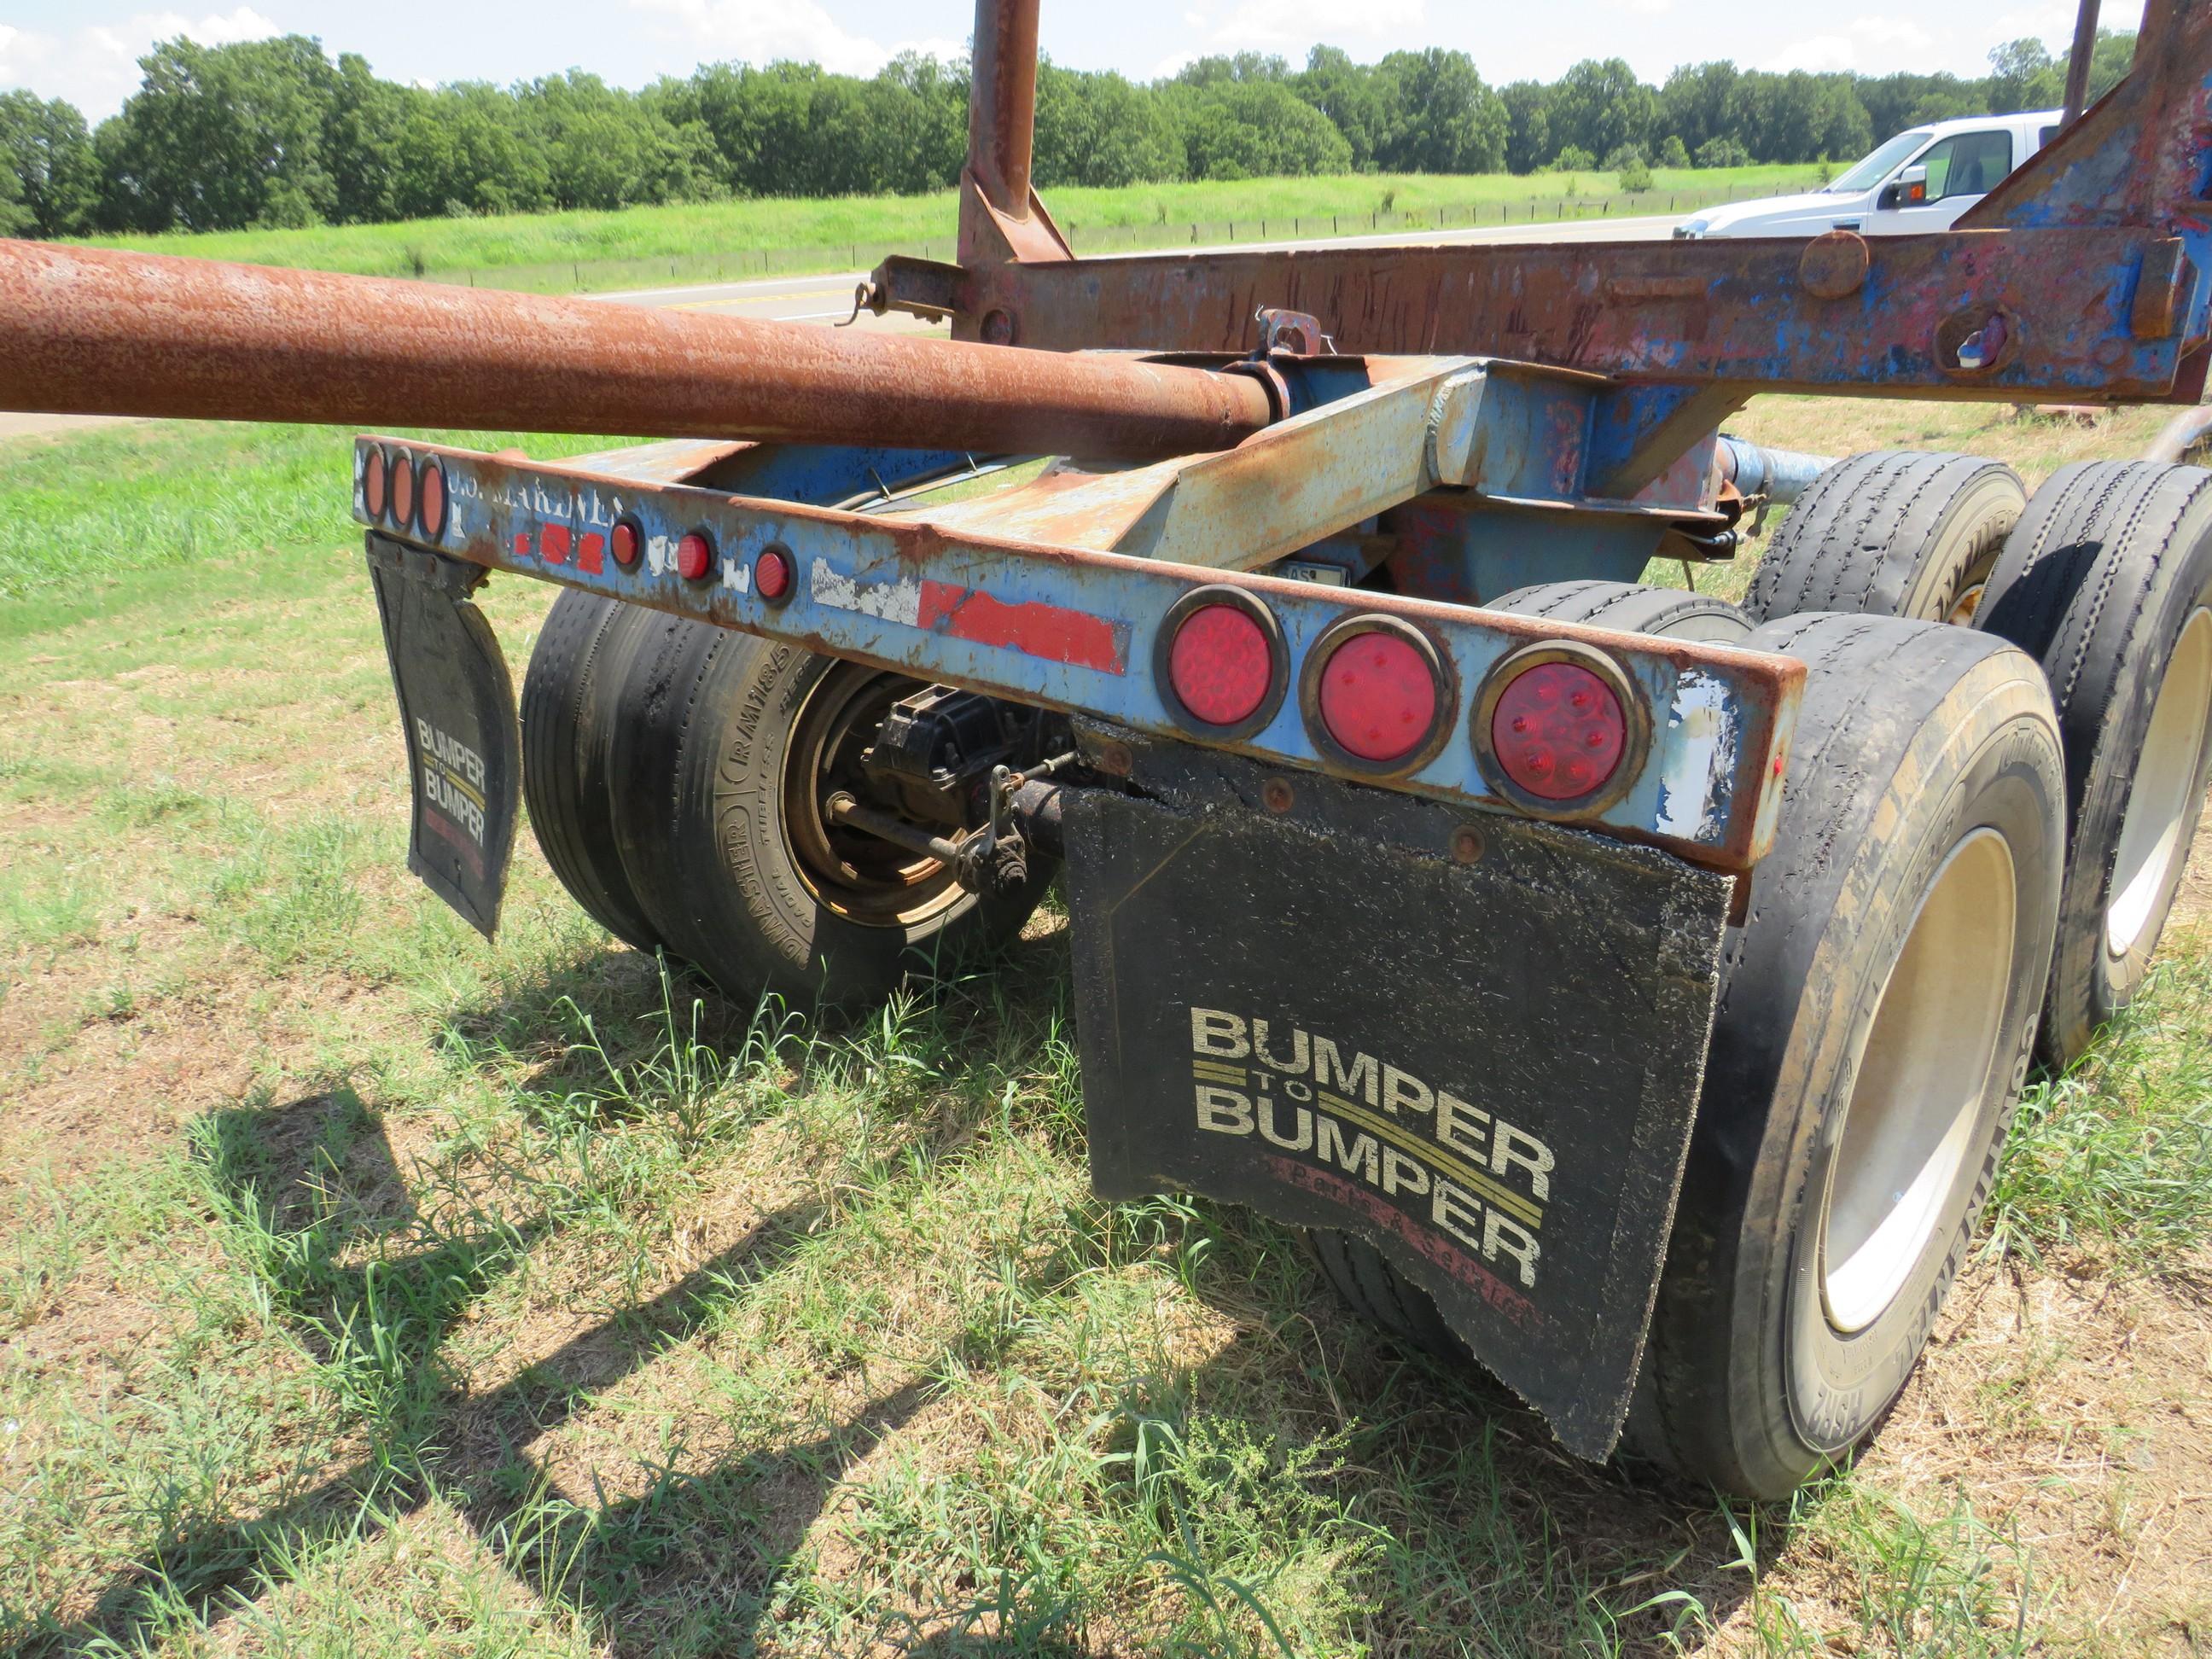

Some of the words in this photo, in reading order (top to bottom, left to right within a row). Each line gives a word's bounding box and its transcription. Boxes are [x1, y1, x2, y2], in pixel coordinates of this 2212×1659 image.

[416, 716, 486, 794] BUMPER
[433, 757, 445, 775] TO
[424, 766, 485, 847] BUMPER
[1190, 1006, 1556, 1203] BUMPER
[1250, 1069, 1313, 1102] TO
[1195, 1084, 1542, 1289] BUMPER
